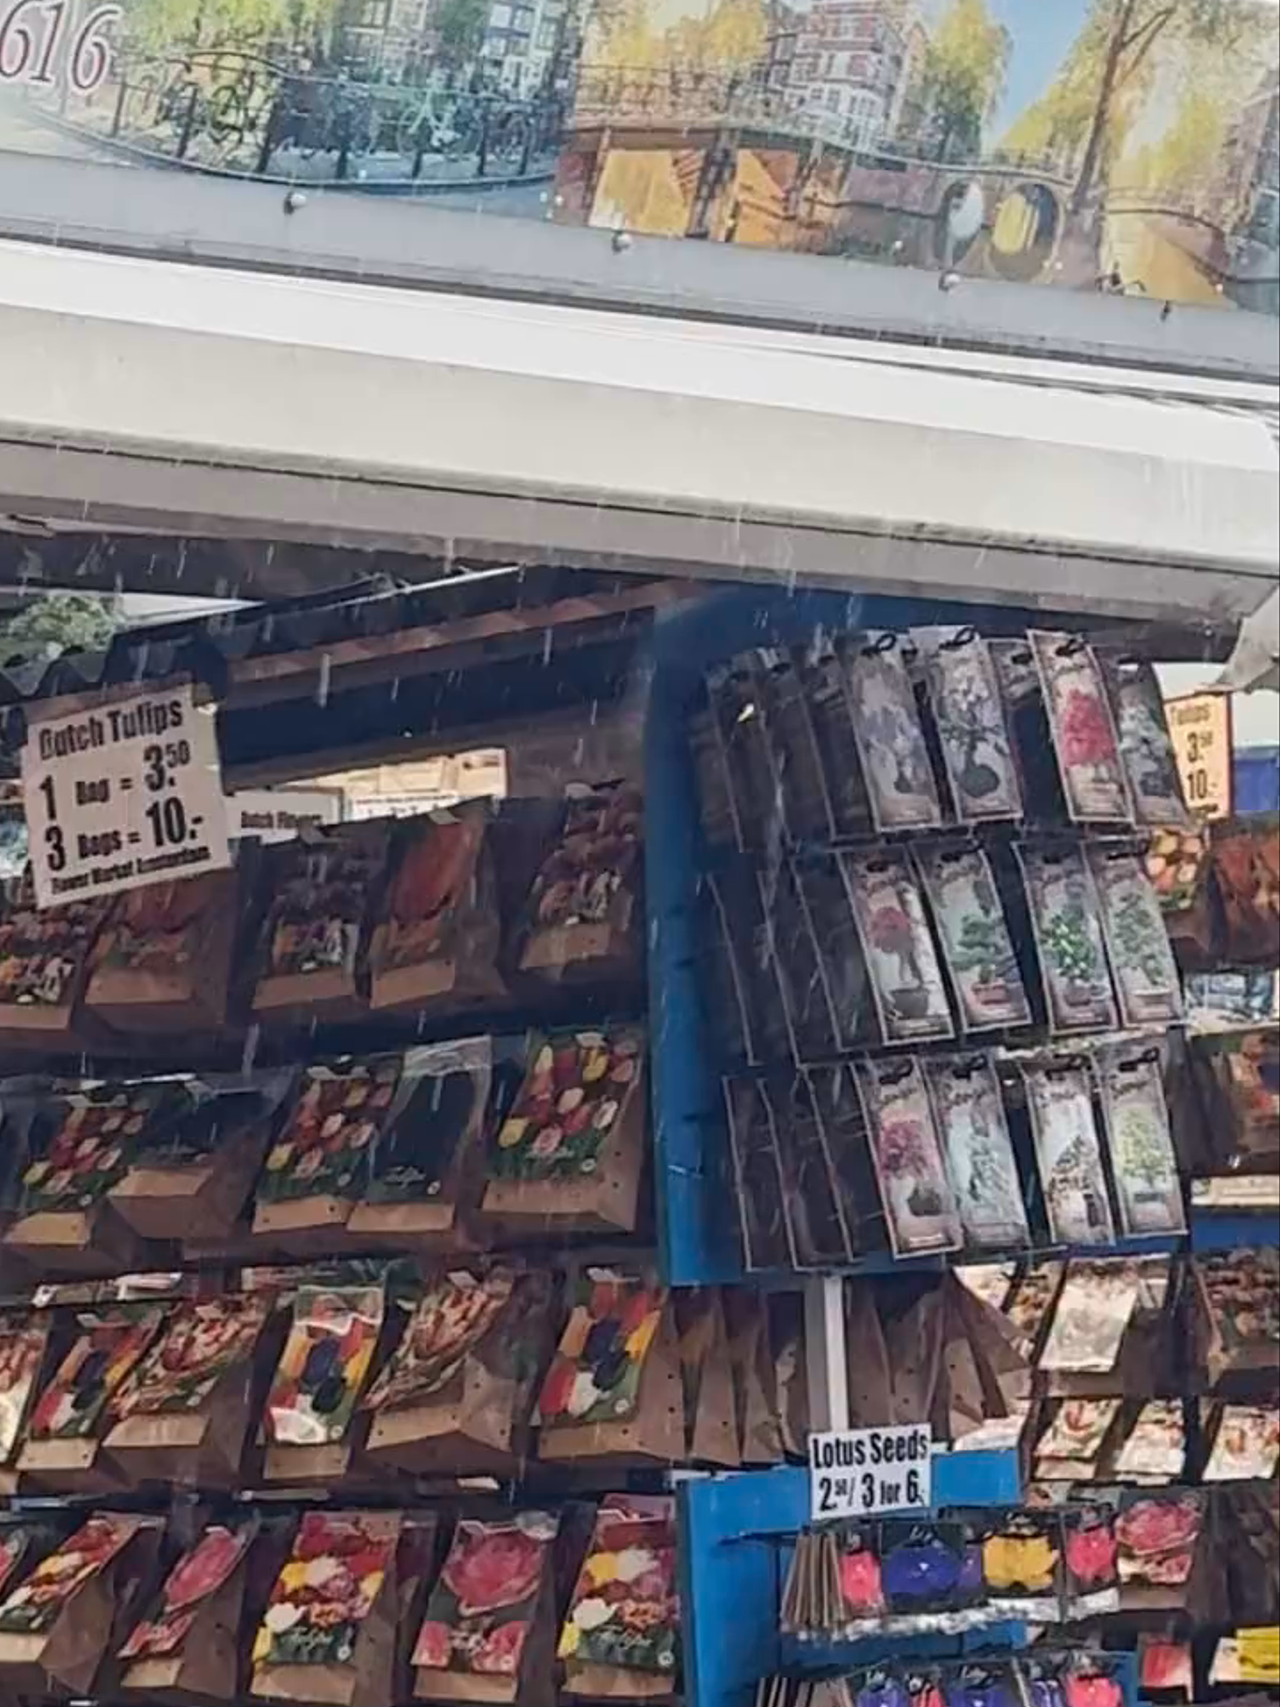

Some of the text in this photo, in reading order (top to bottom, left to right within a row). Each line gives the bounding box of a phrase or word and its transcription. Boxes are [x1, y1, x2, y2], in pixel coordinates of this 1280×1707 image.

[107, 699, 184, 743] Tulips
[39, 775, 57, 821] 1
[142, 739, 191, 792] 3.50
[44, 825, 67, 872] 3
[812, 1428, 928, 1469] Lotus Seeds
[861, 1472, 875, 1509] 3
[879, 1479, 902, 1506] for
